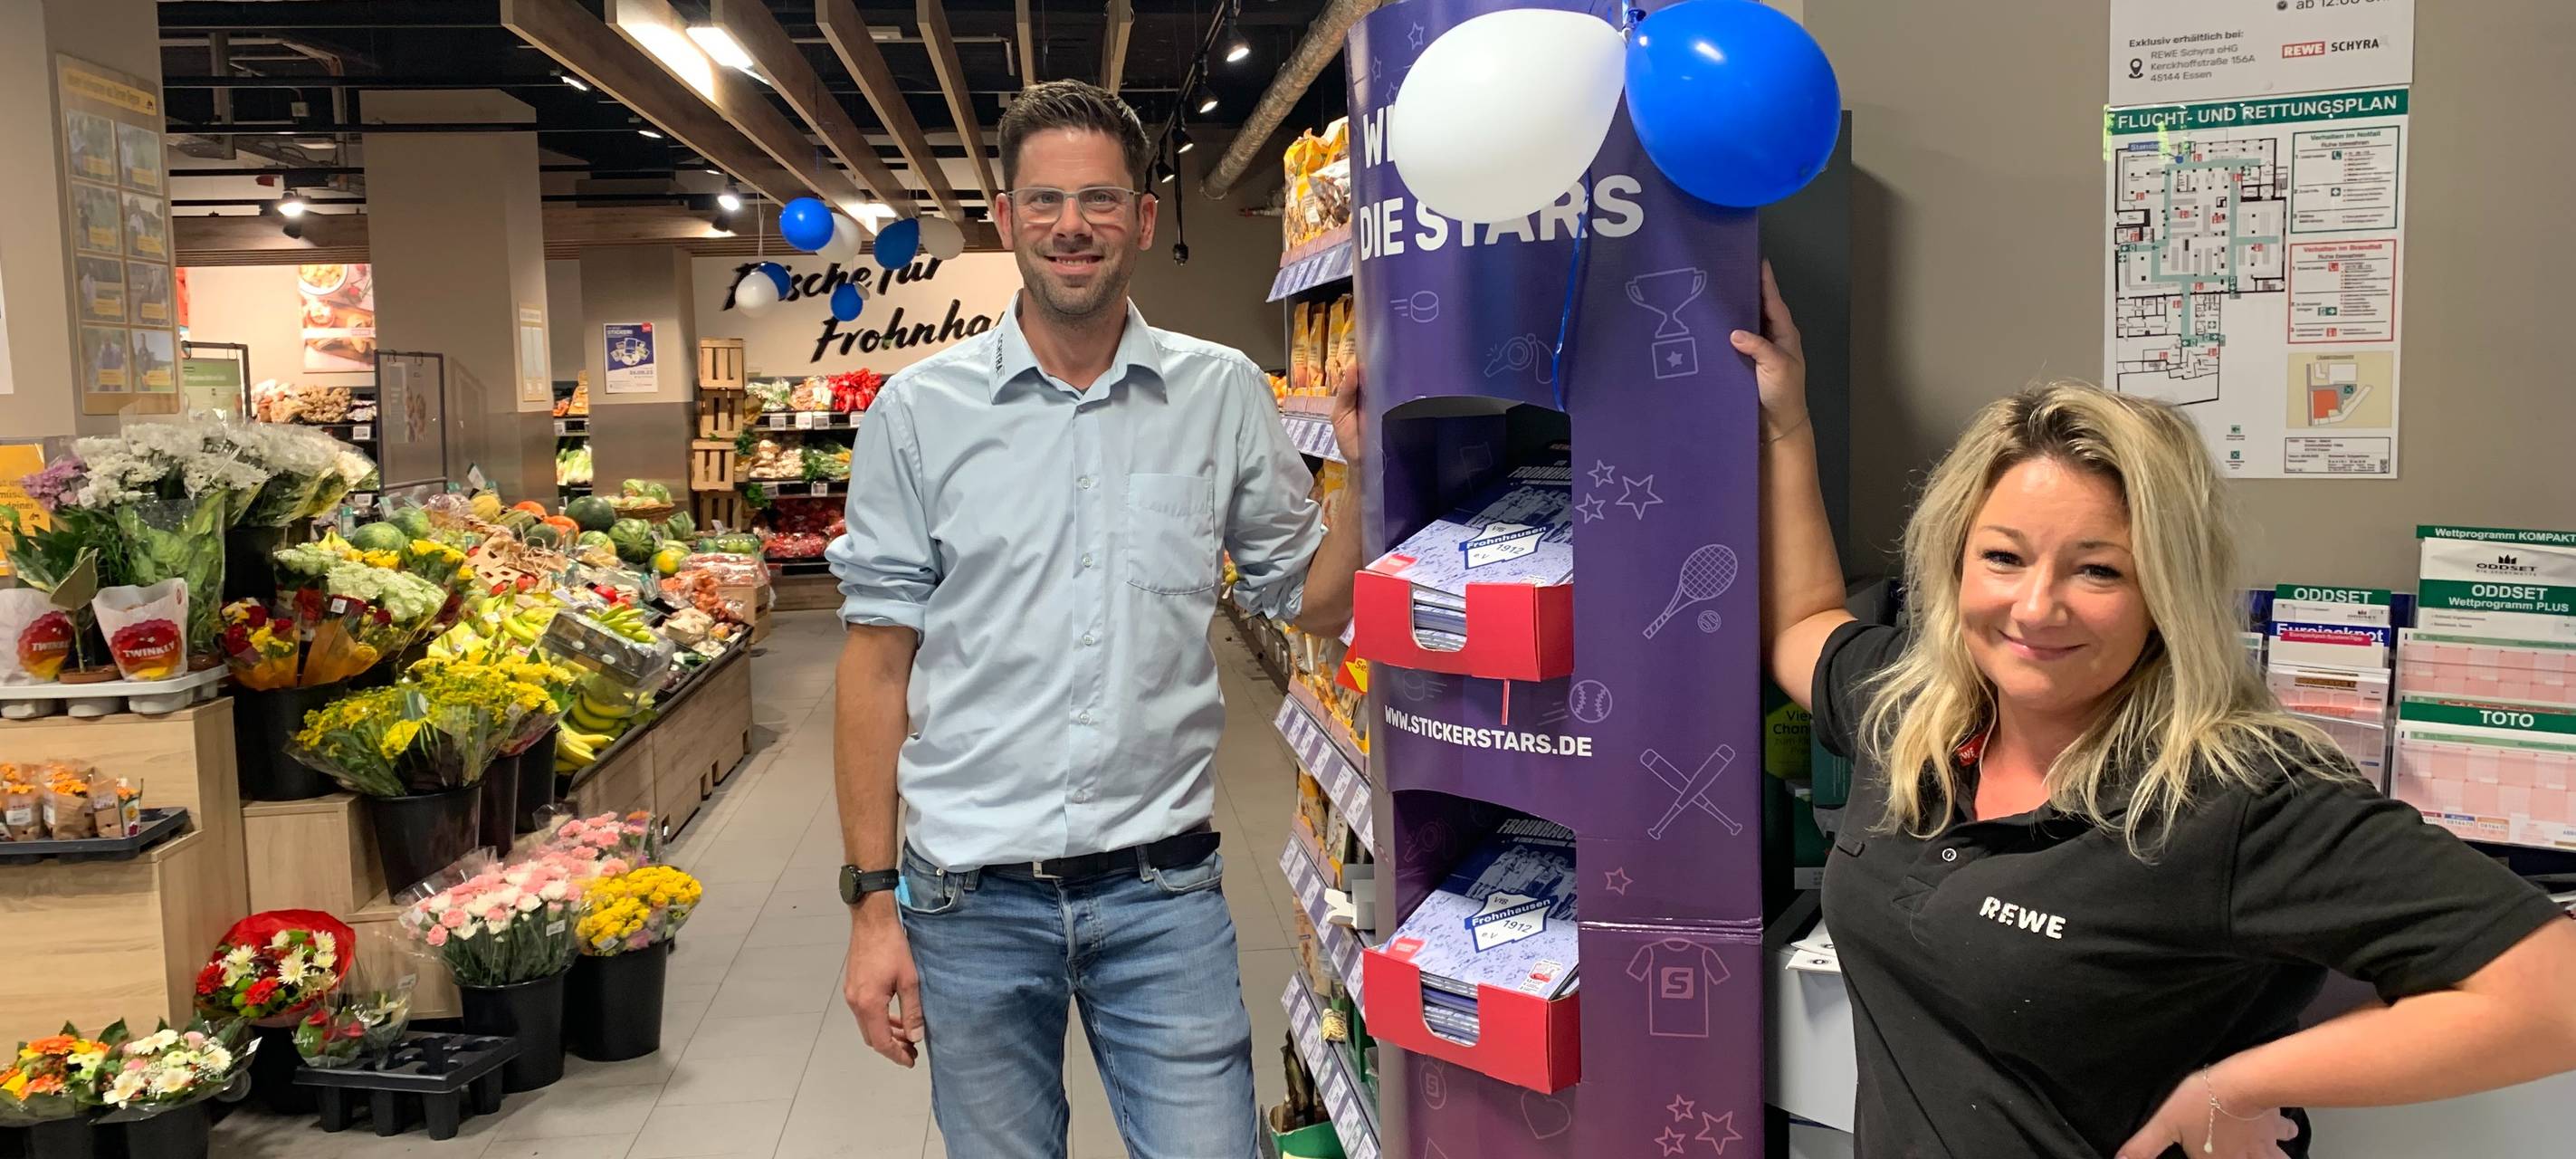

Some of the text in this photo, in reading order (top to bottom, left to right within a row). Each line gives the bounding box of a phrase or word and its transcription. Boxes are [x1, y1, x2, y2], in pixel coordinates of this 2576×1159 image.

[2129, 29, 2244, 48] Exklusiv erhältlich bei:
[2284, 38, 2380, 57] REWE SCHYRA
[2151, 49, 2179, 60] REWE
[2180, 46, 2216, 58] Schyra
[2151, 54, 2256, 72] Kerckhoffstraße 156A
[2151, 70, 2212, 82] 45144 Essen
[2118, 94, 2398, 129] FLUCHT- UND RETTUNGSPLAN
[1360, 197, 1405, 261] DIE
[810, 298, 1006, 363] Frohnha
[1466, 525, 1547, 550] Frohnhausen
[2434, 527, 2576, 543] Wettprogramm KOMPAKT
[1496, 543, 1525, 555] 1912
[2476, 562, 2538, 572] ODDSET
[2294, 587, 2373, 605] ODDSET
[2471, 584, 2548, 601] ODDSET
[2448, 596, 2570, 613] Wettprogramm PLUS
[32, 640, 71, 652] TWINKL
[123, 640, 175, 658] TWINKLY
[2478, 710, 2535, 728] TOTO
[1384, 704, 1593, 758] WWW.STICKERSTARS.DE
[1472, 897, 1551, 927] Frohnhausen
[1979, 896, 2066, 940] REWE
[1503, 919, 1533, 934] 1912
[1665, 972, 1692, 995] S
